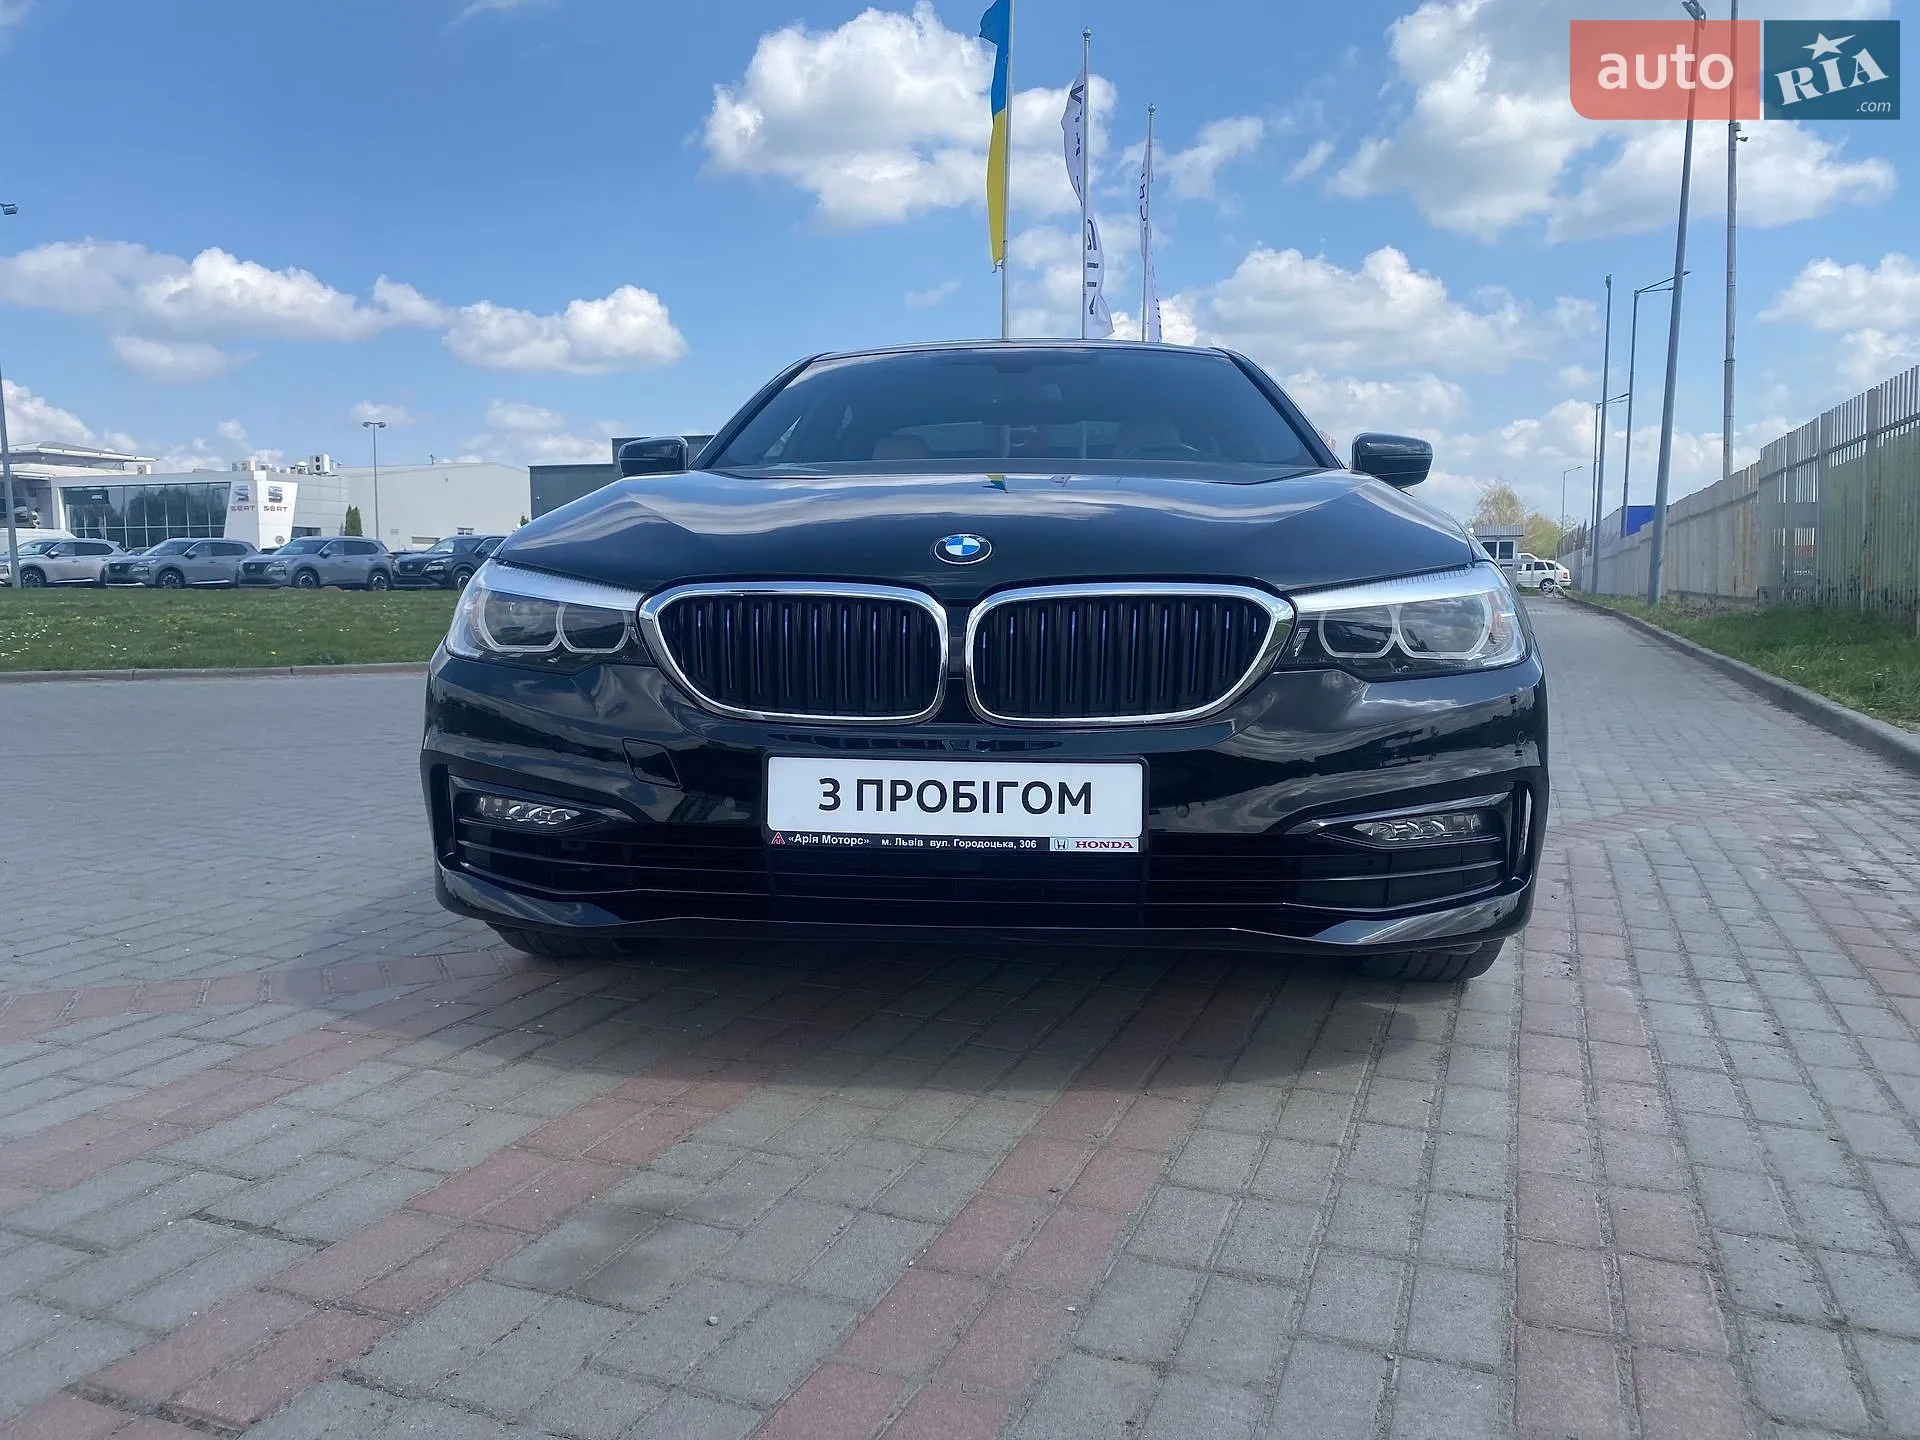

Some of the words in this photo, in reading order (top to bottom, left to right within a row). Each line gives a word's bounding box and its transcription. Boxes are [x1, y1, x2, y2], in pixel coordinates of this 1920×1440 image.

[856, 779, 1092, 815] ПРОБІГОМ
[788, 833, 819, 846] «Арія
[821, 834, 870, 847] Моторс»
[881, 838, 892, 846] м.
[894, 837, 924, 847] Львів
[929, 839, 951, 849] вул.
[953, 838, 1017, 850] Городоцька,
[1019, 839, 1037, 849] 306
[1075, 840, 1134, 849] HONDA
